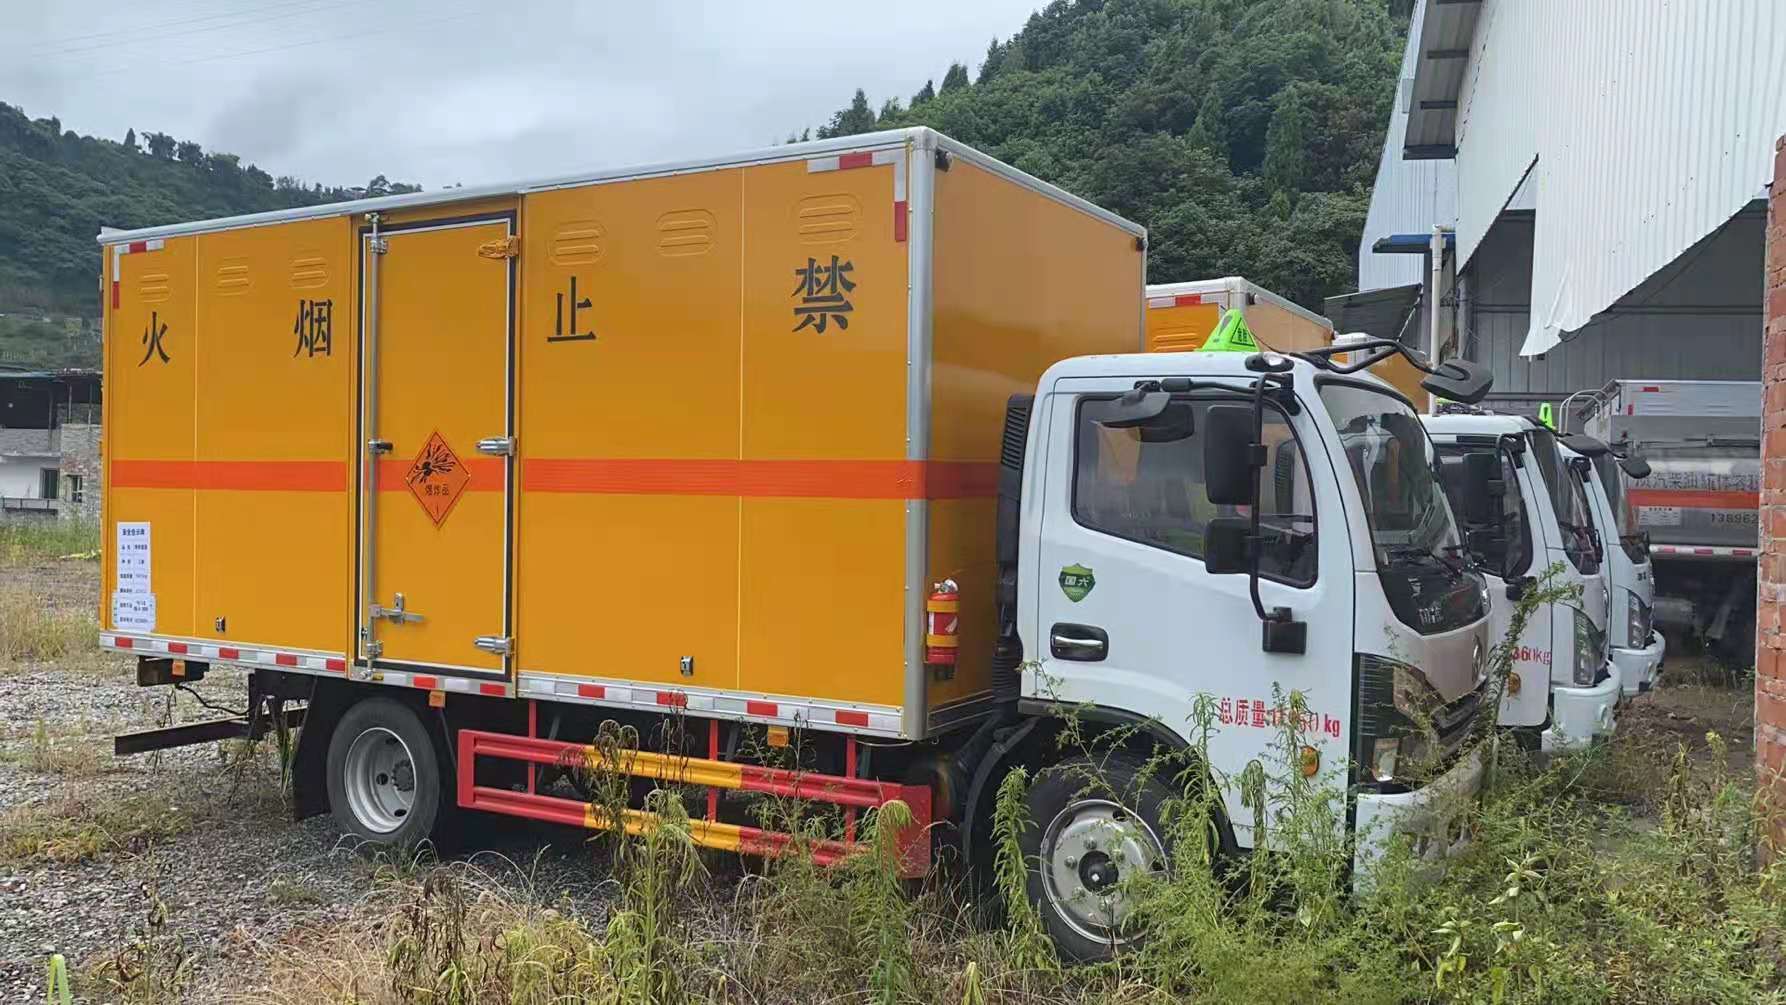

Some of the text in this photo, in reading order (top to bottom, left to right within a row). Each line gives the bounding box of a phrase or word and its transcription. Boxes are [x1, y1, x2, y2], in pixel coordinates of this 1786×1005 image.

[138, 255, 857, 367] 火 烟 止 禁
[1065, 575, 1090, 587] 国六
